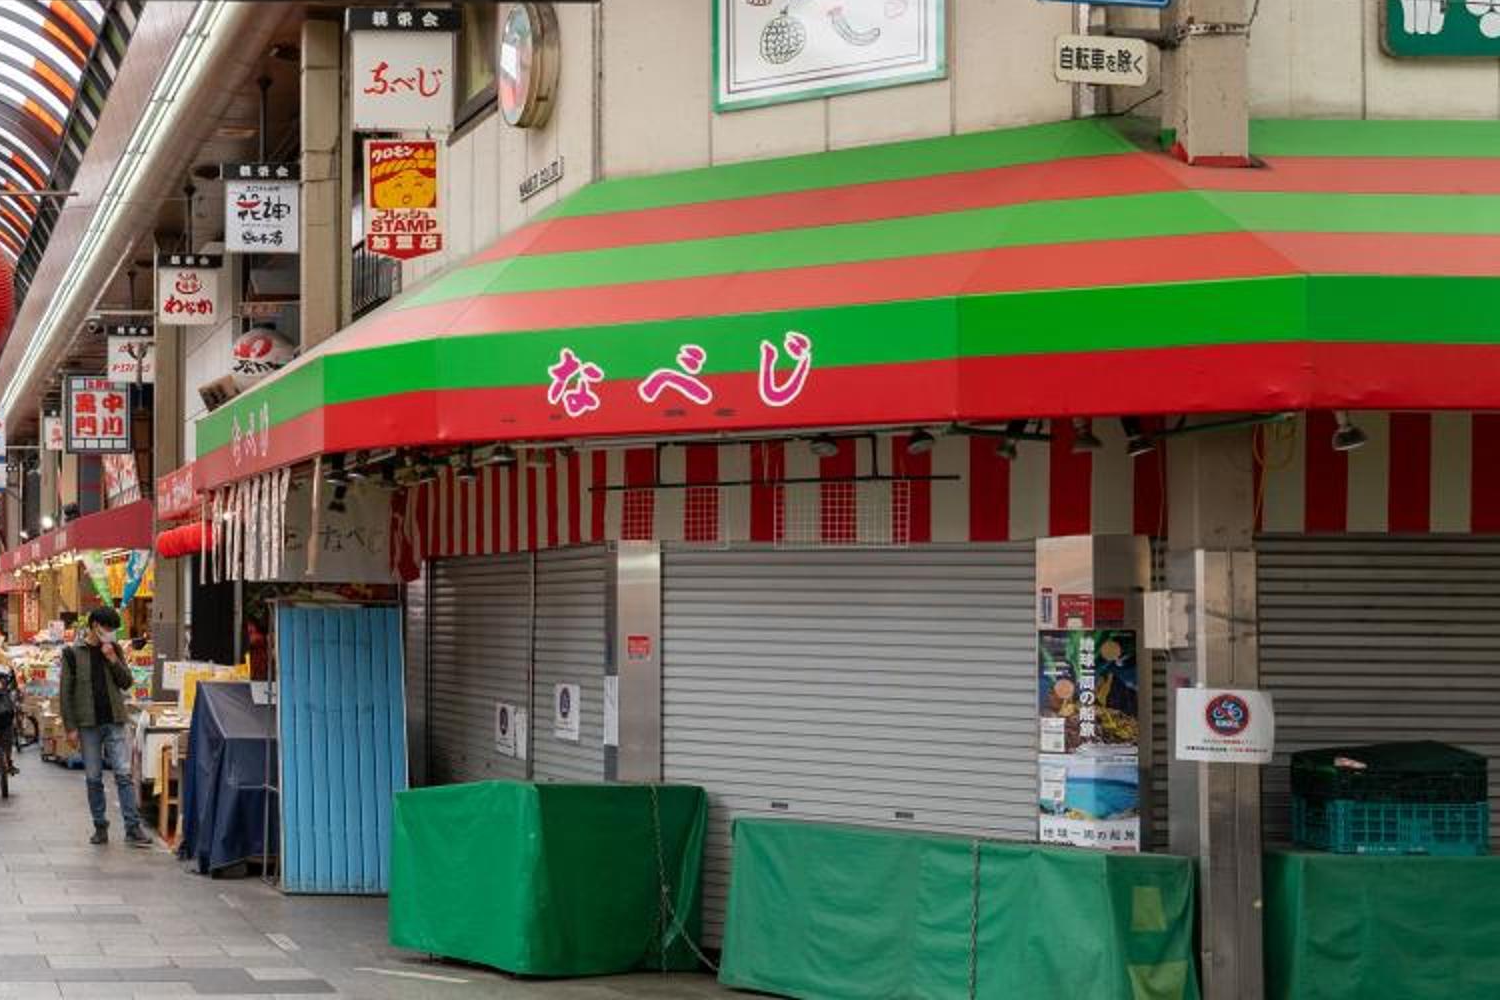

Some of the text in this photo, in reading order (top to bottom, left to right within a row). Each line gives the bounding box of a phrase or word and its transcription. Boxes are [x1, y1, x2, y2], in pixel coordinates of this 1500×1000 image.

[1058, 45, 1145, 75] 自転車を除く
[371, 219, 437, 233] STAMP
[546, 331, 812, 417] なべじ
